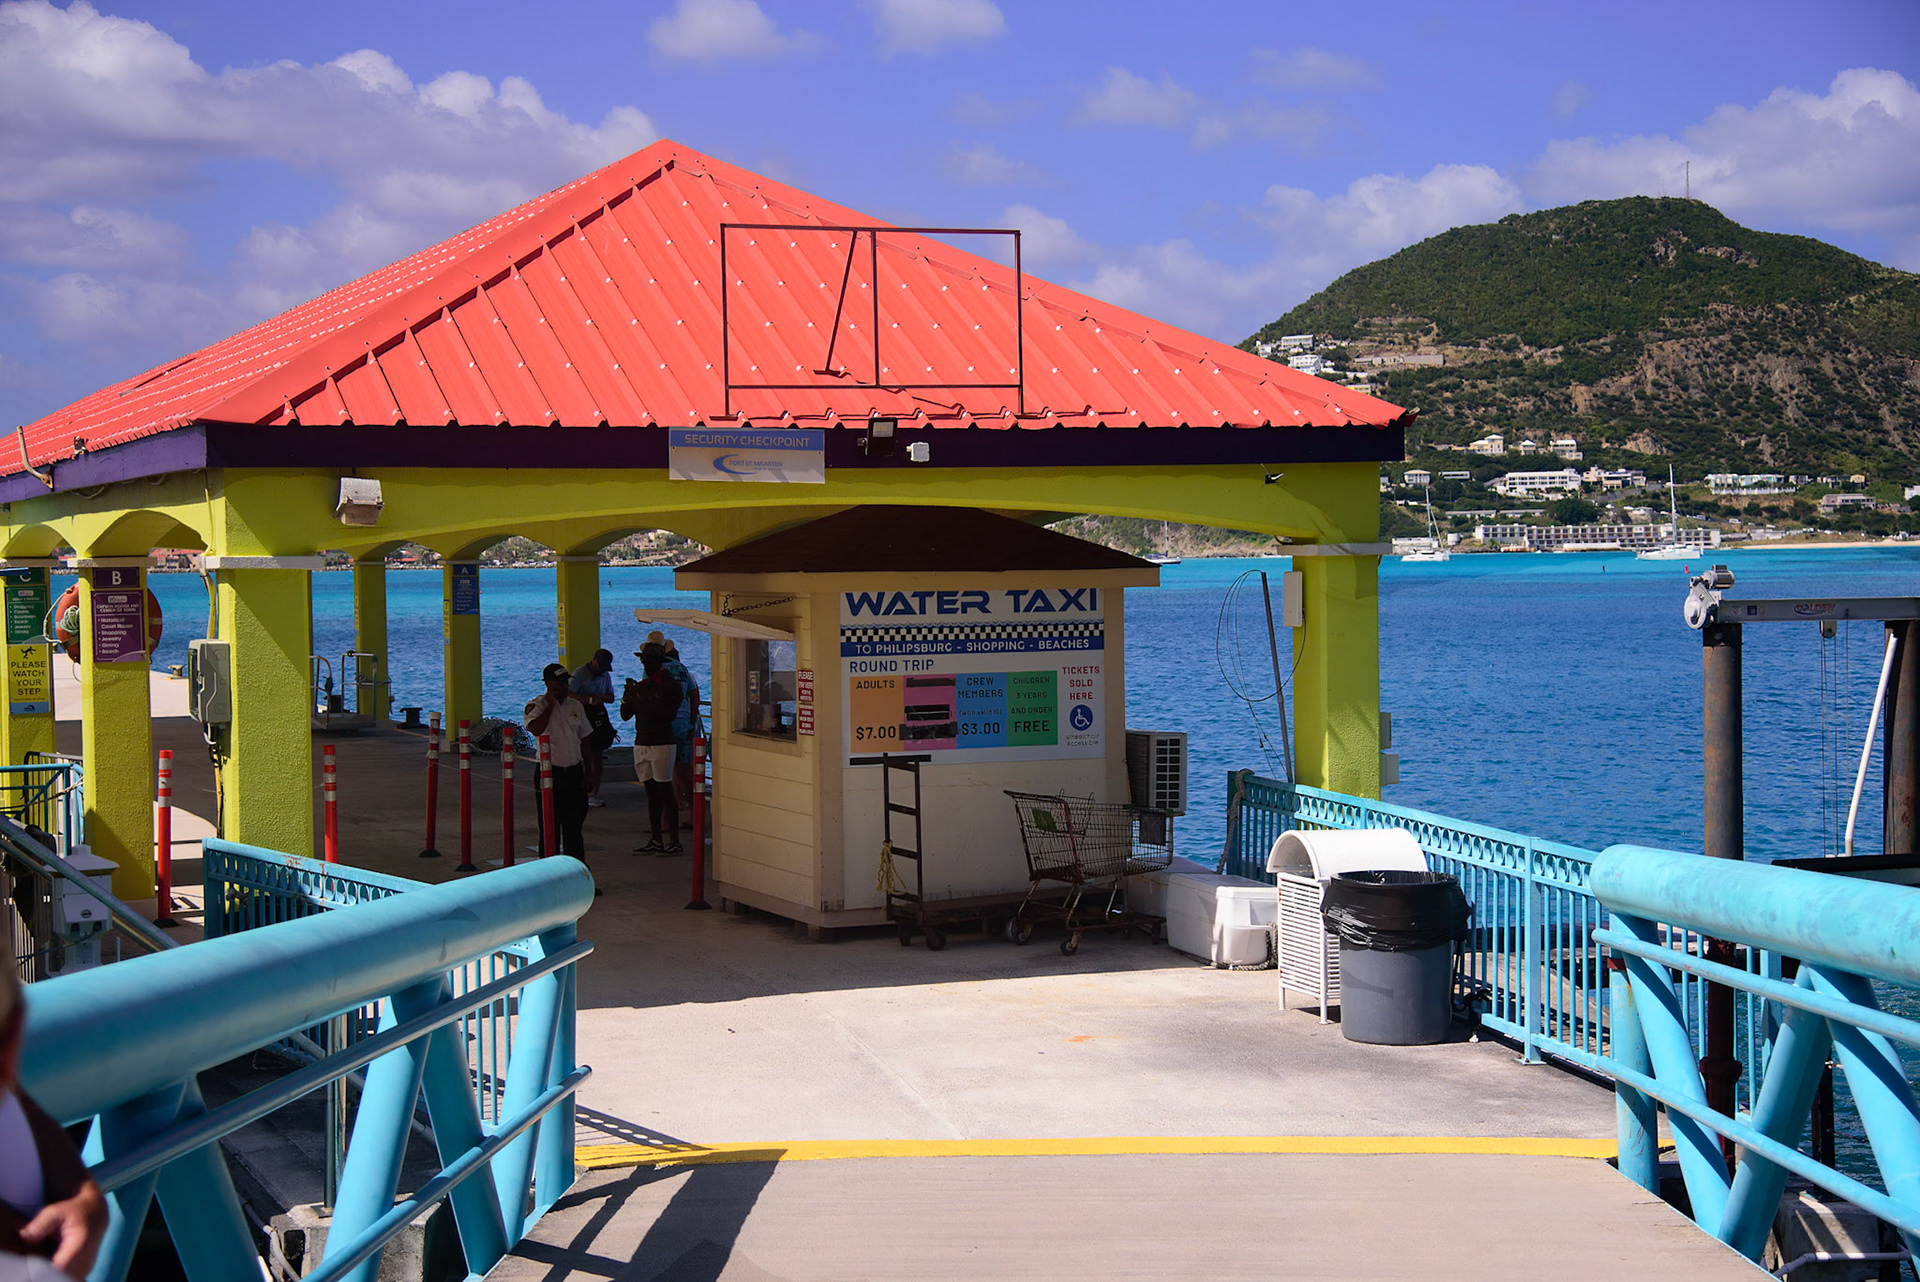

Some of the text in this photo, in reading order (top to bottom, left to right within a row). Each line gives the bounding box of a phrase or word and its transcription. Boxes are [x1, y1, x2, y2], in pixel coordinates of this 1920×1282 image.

[684, 434, 810, 448] SECURITY CHECKPOINT
[461, 566, 468, 575] A
[112, 570, 122, 585] B
[845, 588, 1097, 616] WATER TAXI
[856, 644, 872, 654] TO
[876, 642, 952, 654] PHILIPSBURG
[966, 640, 1025, 652] SHOPPING
[1038, 639, 1090, 650] BEACHES
[850, 660, 934, 673] ROUND TRIP
[1062, 666, 1100, 674] TICKETS
[856, 680, 895, 690] ADULTS
[966, 677, 994, 686] CREW
[1012, 676, 1050, 684] CHILDREN
[1069, 679, 1093, 688] SOLD
[958, 689, 1004, 699] MEMBERS
[1069, 692, 1093, 700] HERE
[1028, 706, 1053, 714] UNDER
[962, 722, 1000, 736] $3.00
[1014, 720, 1050, 733] FREE
[856, 726, 896, 740] $7.00
